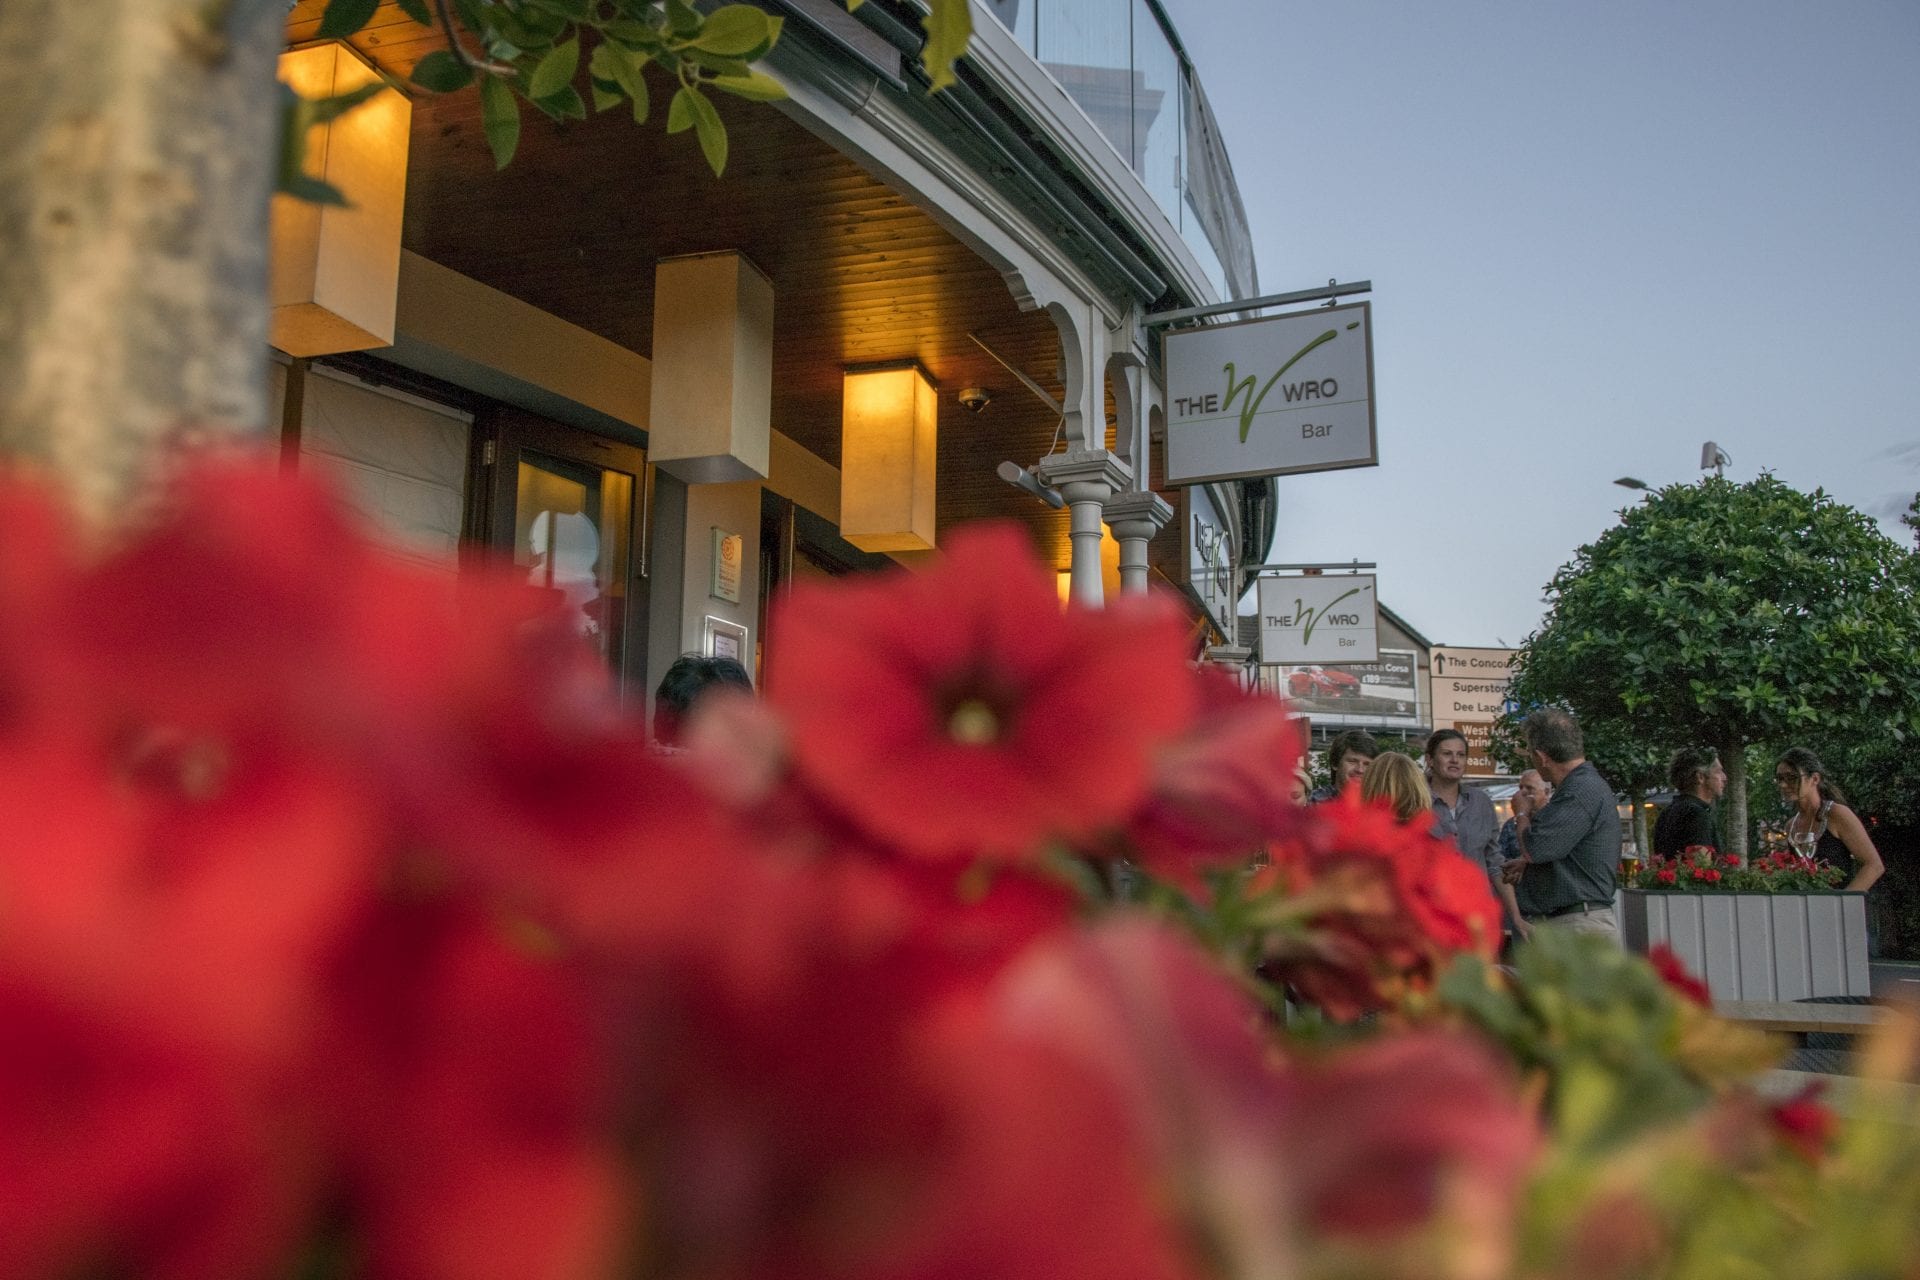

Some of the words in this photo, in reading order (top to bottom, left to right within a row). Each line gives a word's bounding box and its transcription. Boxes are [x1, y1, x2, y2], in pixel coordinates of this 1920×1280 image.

[1175, 394, 1219, 416] THE
[1283, 377, 1339, 403] WRO
[1302, 424, 1333, 439] Bar
[1266, 616, 1292, 627] THE
[1328, 614, 1360, 626] WRO
[1338, 638, 1357, 647] Bar
[1385, 663, 1409, 673] Corsa
[1448, 657, 1467, 667] The
[1470, 658, 1510, 669] Concou
[1453, 682, 1508, 693] Superstor
[1454, 702, 1474, 712] Dee
[1462, 725, 1489, 736] West
[1466, 757, 1491, 766] each
